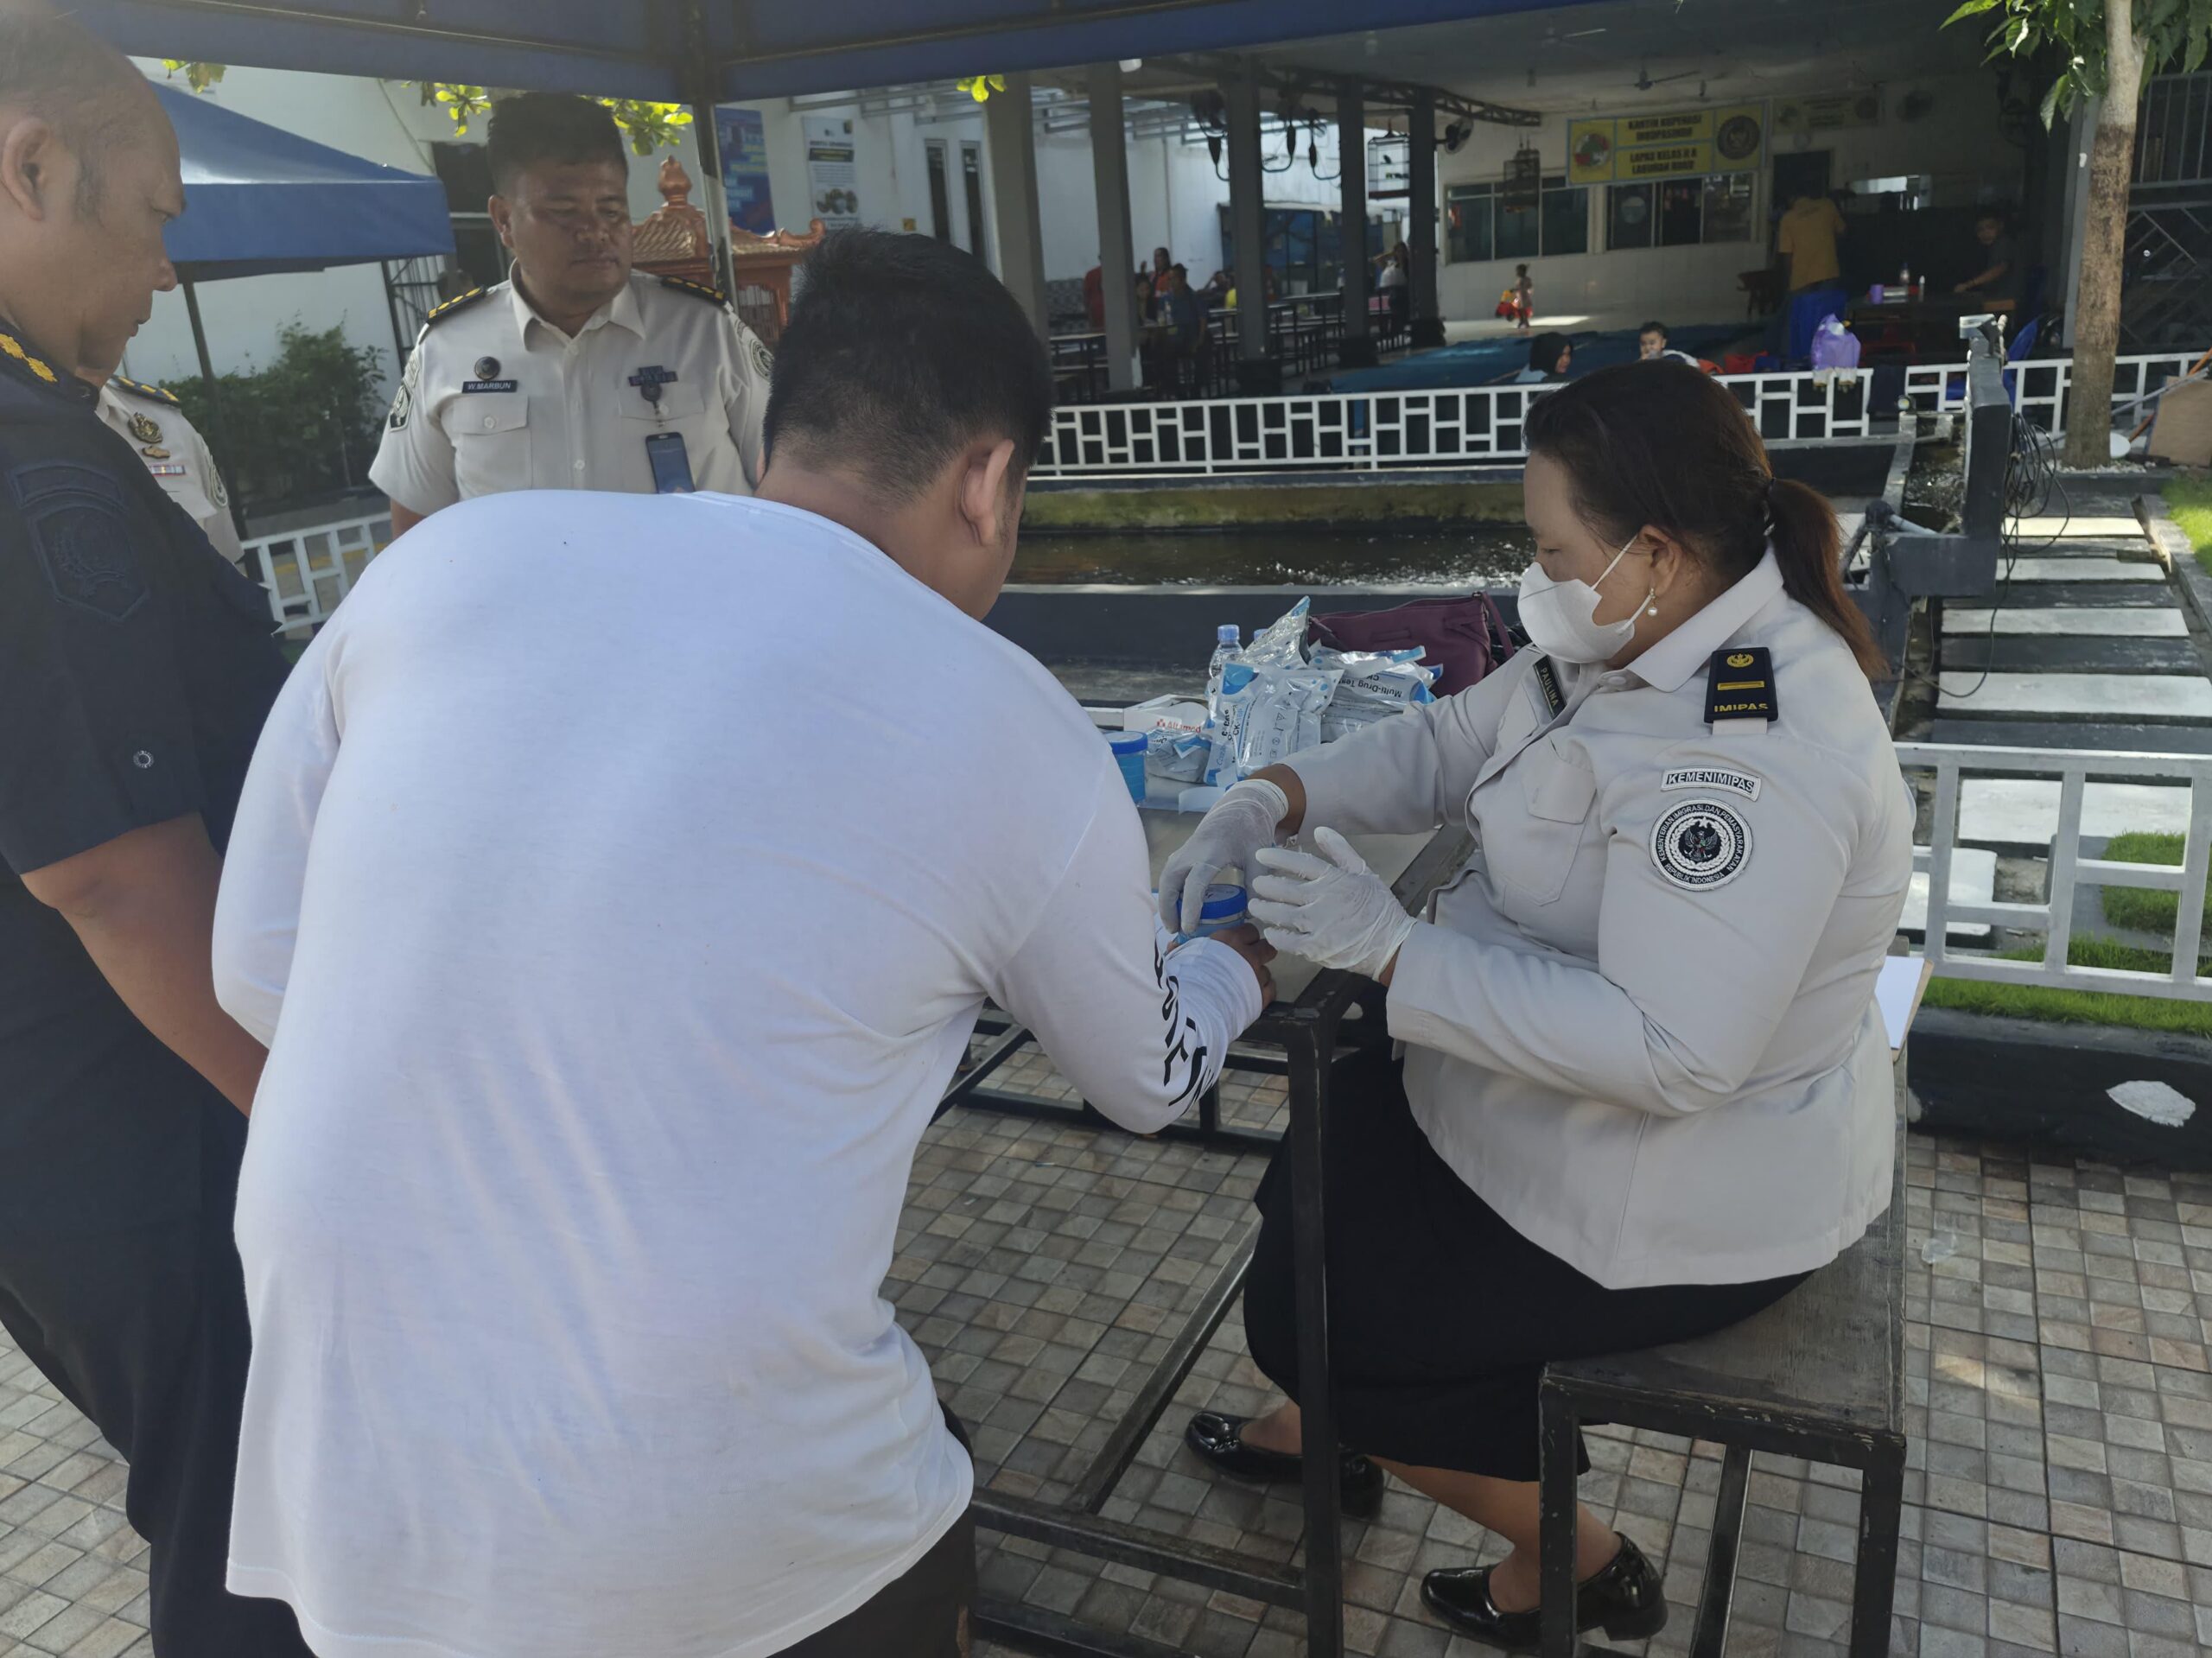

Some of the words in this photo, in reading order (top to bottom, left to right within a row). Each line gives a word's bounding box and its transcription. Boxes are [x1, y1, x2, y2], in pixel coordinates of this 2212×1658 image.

[467, 382, 512, 391] W.MARBUN
[1357, 680, 1402, 698] Multi-Drug
[1540, 666, 1560, 707] PAULINA
[1713, 702, 1769, 713] IMIPAS
[1668, 772, 1754, 792] KEMENIMIPAS
[1657, 816, 1675, 861] KEMENTERIAN
[1672, 804, 1703, 820] IMIGRASI
[1704, 804, 1720, 816] DAN
[1720, 811, 1744, 872] PEMASYARAKATAN
[1664, 863, 1692, 883] REPUBLIK
[1691, 871, 1726, 884] INDONESIA
